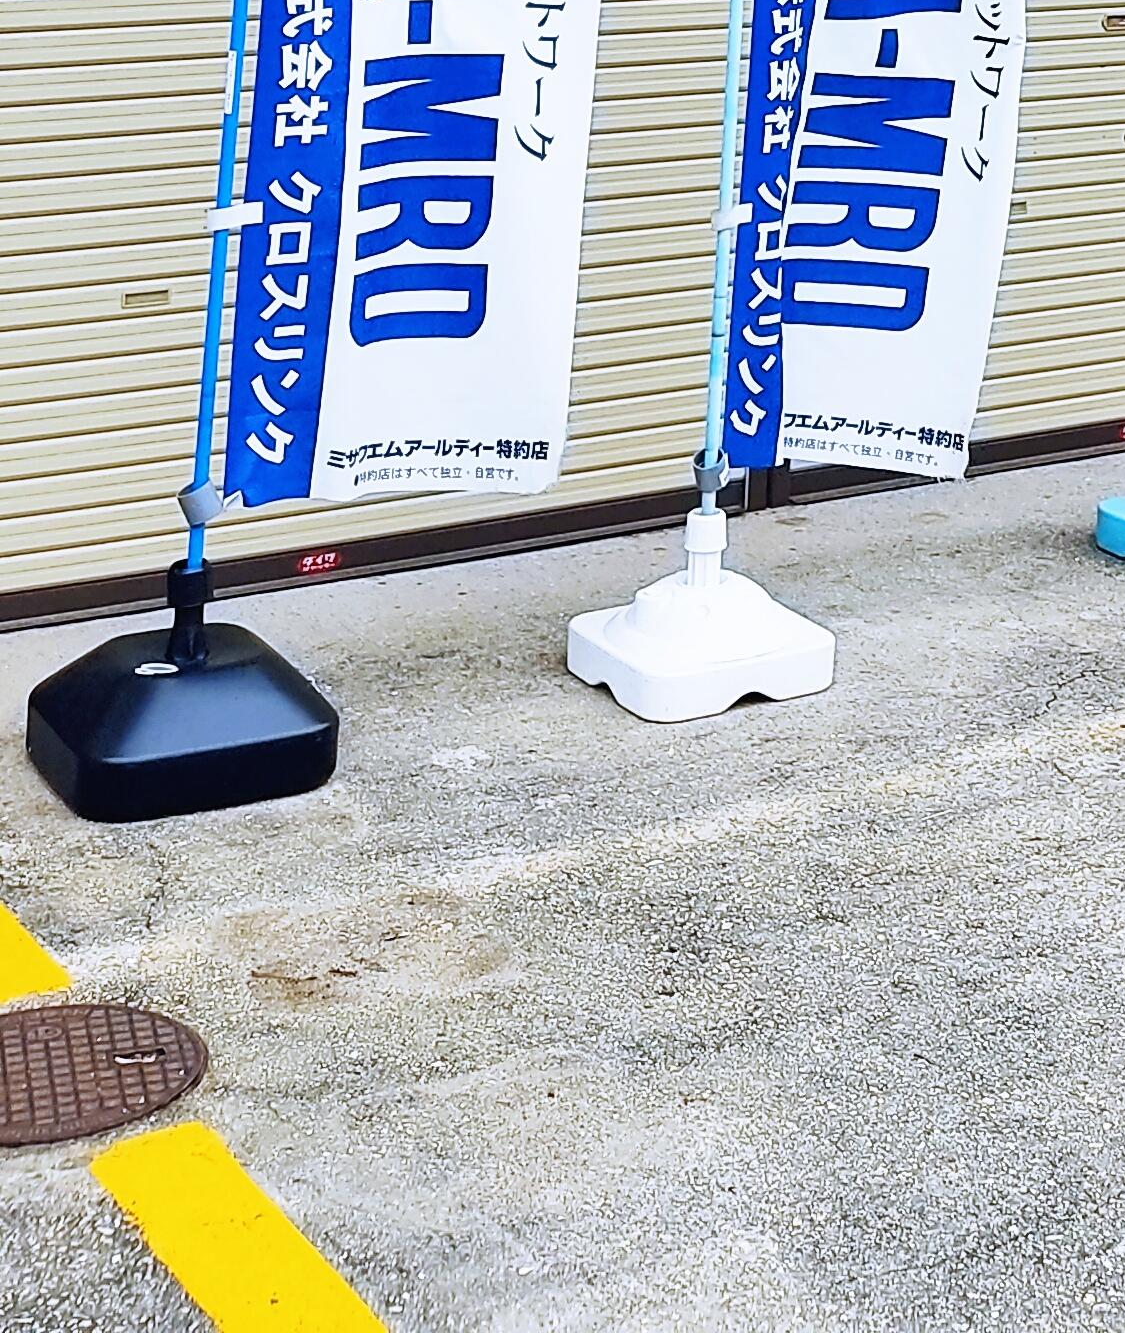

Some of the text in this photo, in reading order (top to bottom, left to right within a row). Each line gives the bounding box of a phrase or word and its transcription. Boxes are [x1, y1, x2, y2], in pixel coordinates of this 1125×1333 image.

[245, 170, 322, 466] クロスリンク
[729, 174, 790, 438] クロスリンク
[326, 438, 550, 469] ミサワエムアールディー特約店
